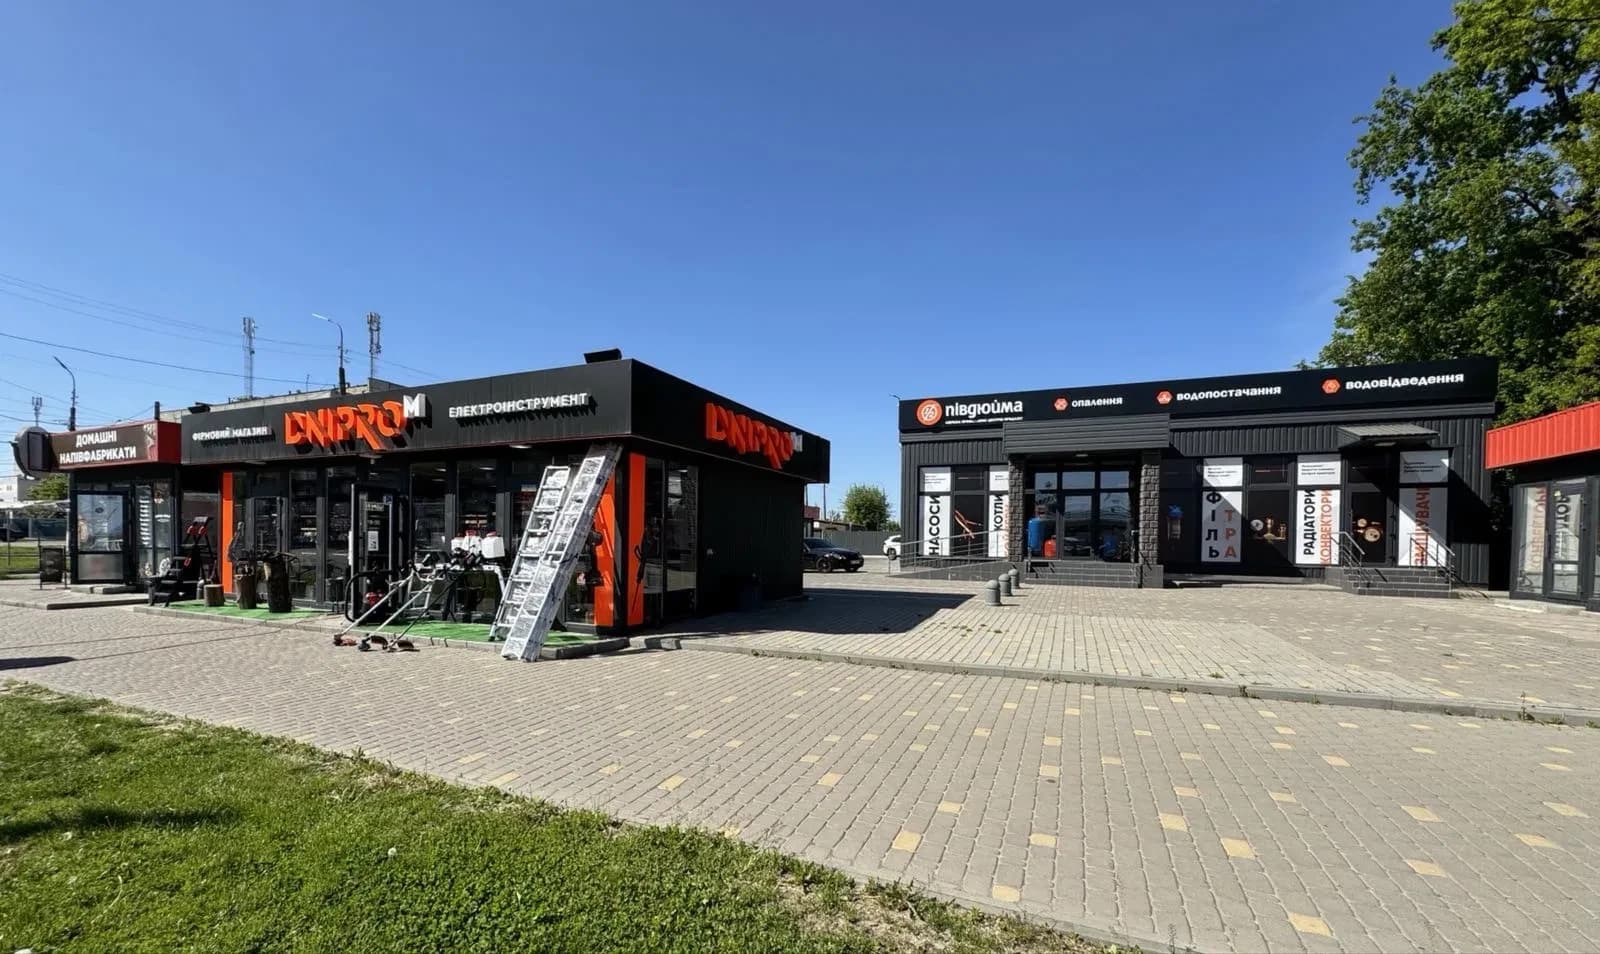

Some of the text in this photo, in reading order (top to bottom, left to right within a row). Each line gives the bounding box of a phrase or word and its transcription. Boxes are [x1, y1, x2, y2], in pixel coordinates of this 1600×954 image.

[1345, 373, 1465, 390] водовідведення
[1071, 397, 1123, 408] опалення
[1176, 386, 1282, 401] водопостачання
[448, 393, 589, 418] ЕЛЕКТРОІНСТРУМЕНТ
[945, 400, 1023, 418] півдюйма
[76, 430, 117, 448] ДОМАШНІ
[192, 426, 269, 441] ФІРМОВИЙ МАГАЗИН
[60, 446, 136, 464] НАПІВФАБРИКАТИ
[993, 494, 1004, 531] КОТЛИ
[928, 494, 941, 555] НАСОСИ
[1303, 489, 1317, 555] РАДІАТОРИ
